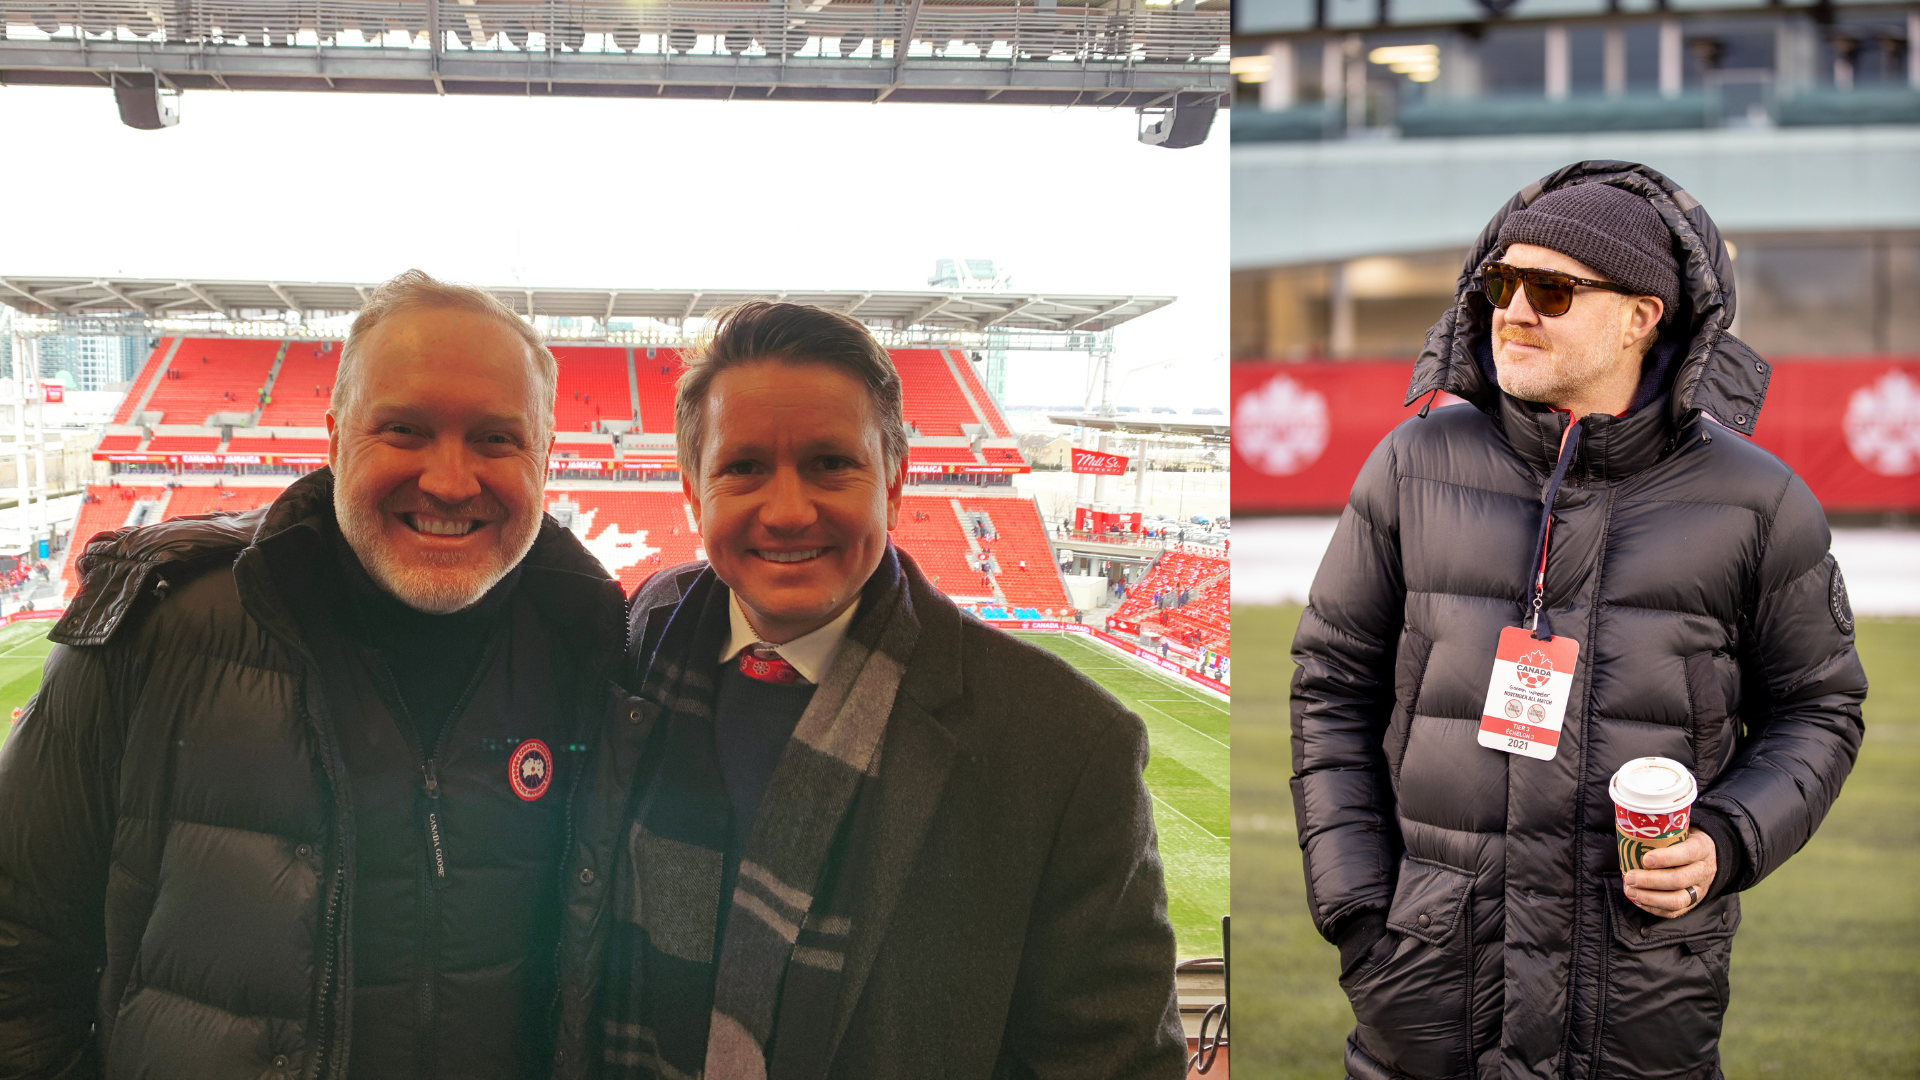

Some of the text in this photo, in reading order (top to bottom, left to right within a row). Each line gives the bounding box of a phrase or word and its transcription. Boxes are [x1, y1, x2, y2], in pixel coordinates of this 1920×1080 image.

[182, 455, 216, 464] CANADA
[223, 455, 261, 464] JAMAICA
[567, 461, 602, 470] JAMAICA
[907, 465, 943, 473] JAMAICA
[1517, 664, 1551, 677] CANADA
[1504, 691, 1528, 700] NOVEMBER
[1514, 723, 1526, 731] TIER
[1507, 738, 1529, 750] 2021
[430, 813, 444, 877] CANADA GOOSE
